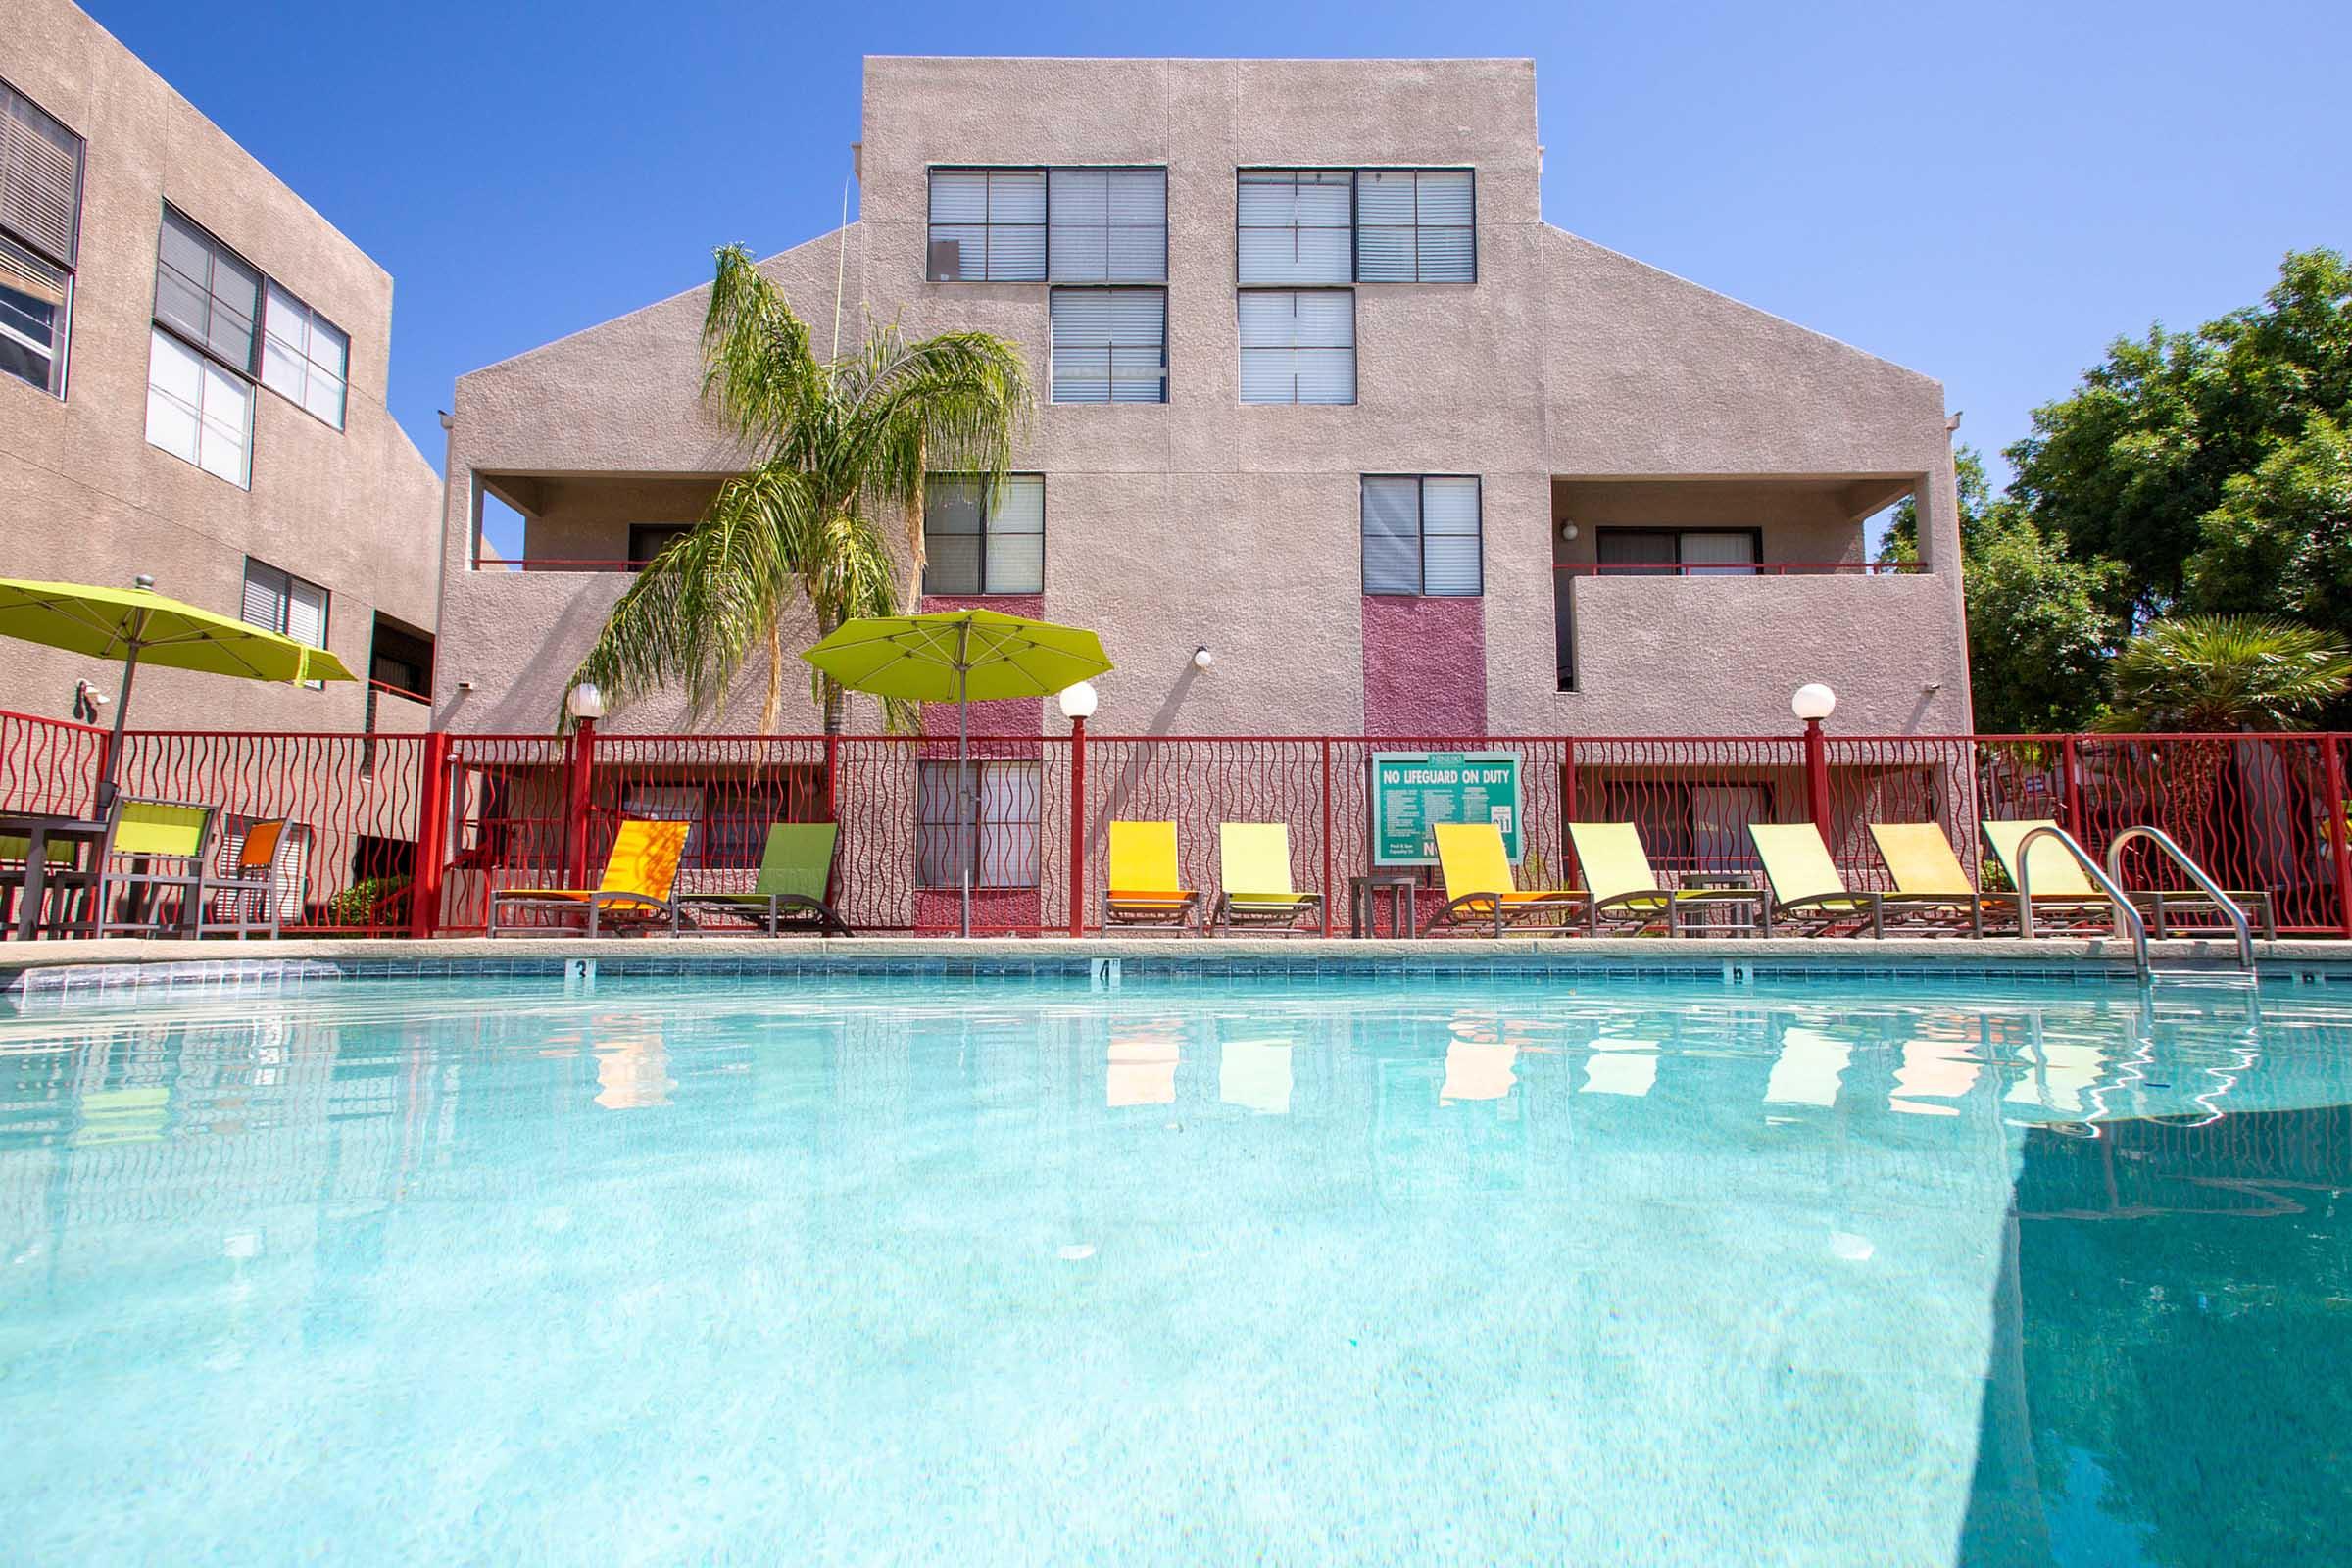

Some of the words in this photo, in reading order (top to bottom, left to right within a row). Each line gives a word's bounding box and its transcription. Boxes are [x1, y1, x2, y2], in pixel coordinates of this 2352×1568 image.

[1383, 769, 1400, 784] NO
[1403, 769, 1458, 784] LIFEGUARD
[1461, 769, 1479, 784] ON
[1483, 769, 1510, 784] DUTY
